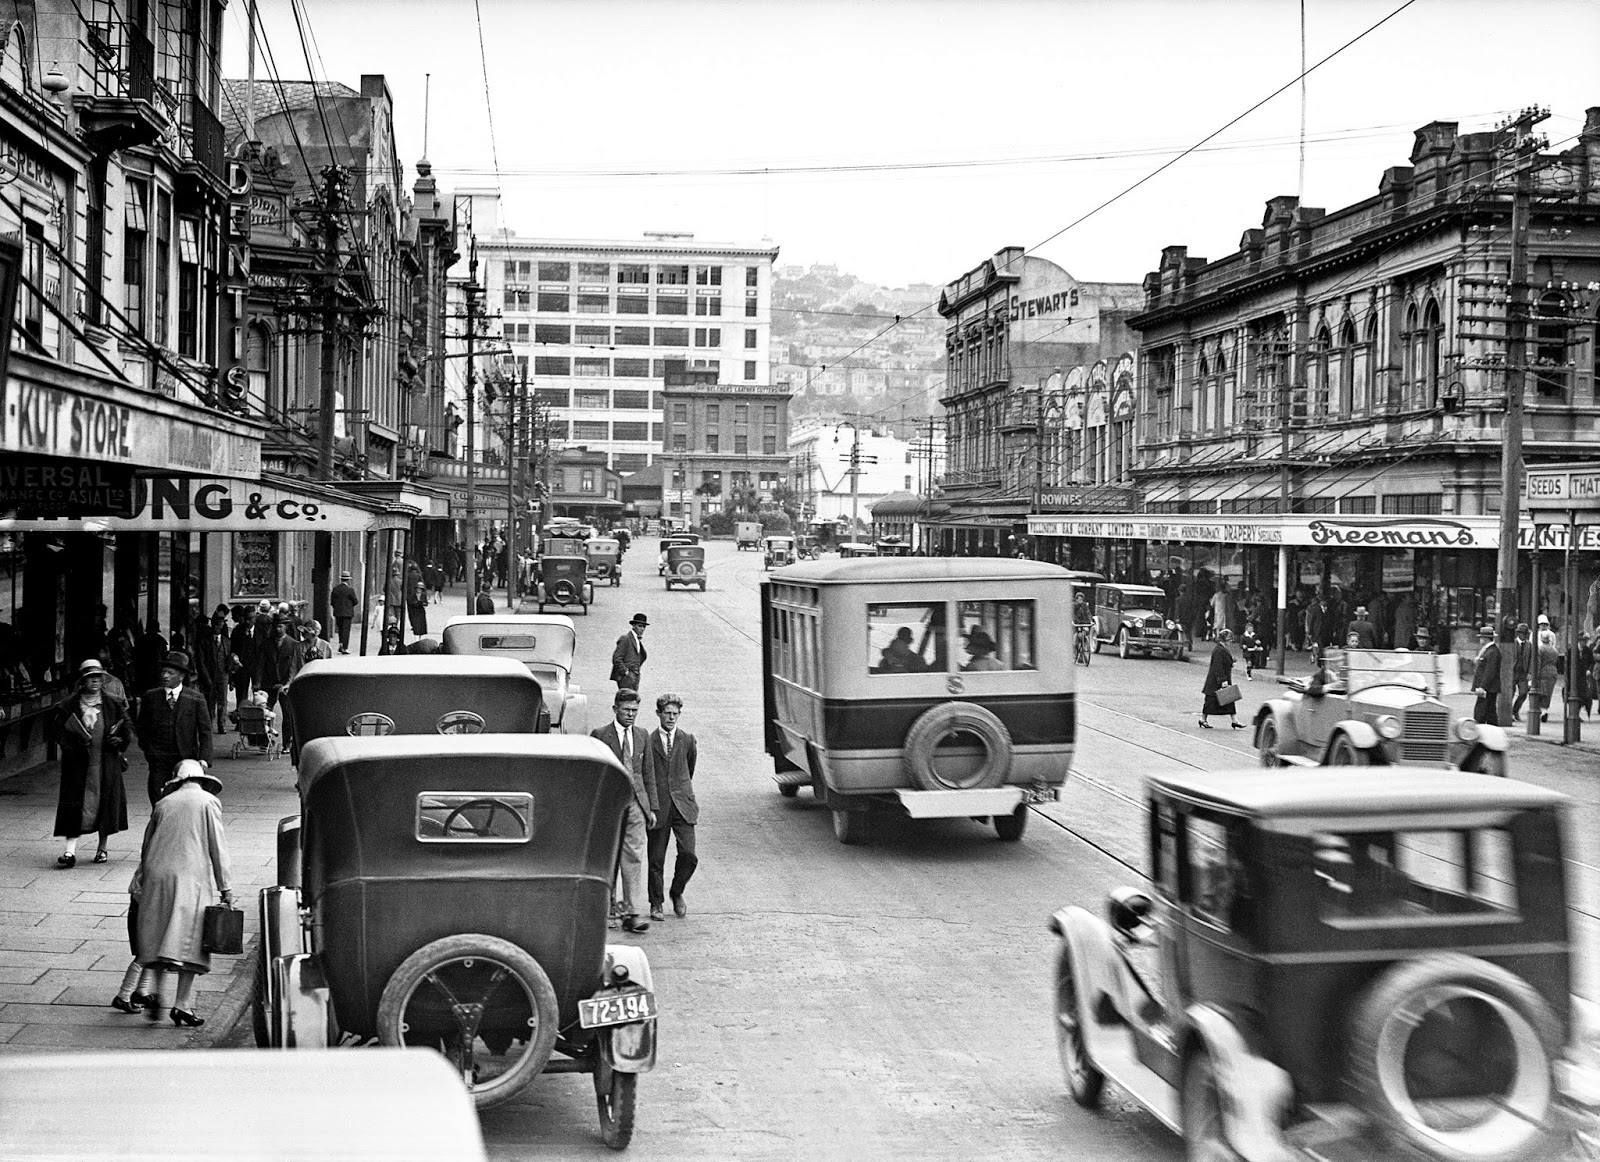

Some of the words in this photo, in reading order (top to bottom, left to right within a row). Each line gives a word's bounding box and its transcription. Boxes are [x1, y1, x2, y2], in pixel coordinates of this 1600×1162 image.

[70, 396, 130, 458] STORE
[1531, 478, 1562, 495] SEEDS
[1573, 477, 1600, 494] THAT
[245, 492, 271, 520] &
[1224, 524, 1258, 541] DRAPERY
[587, 994, 650, 1025] 72-194
